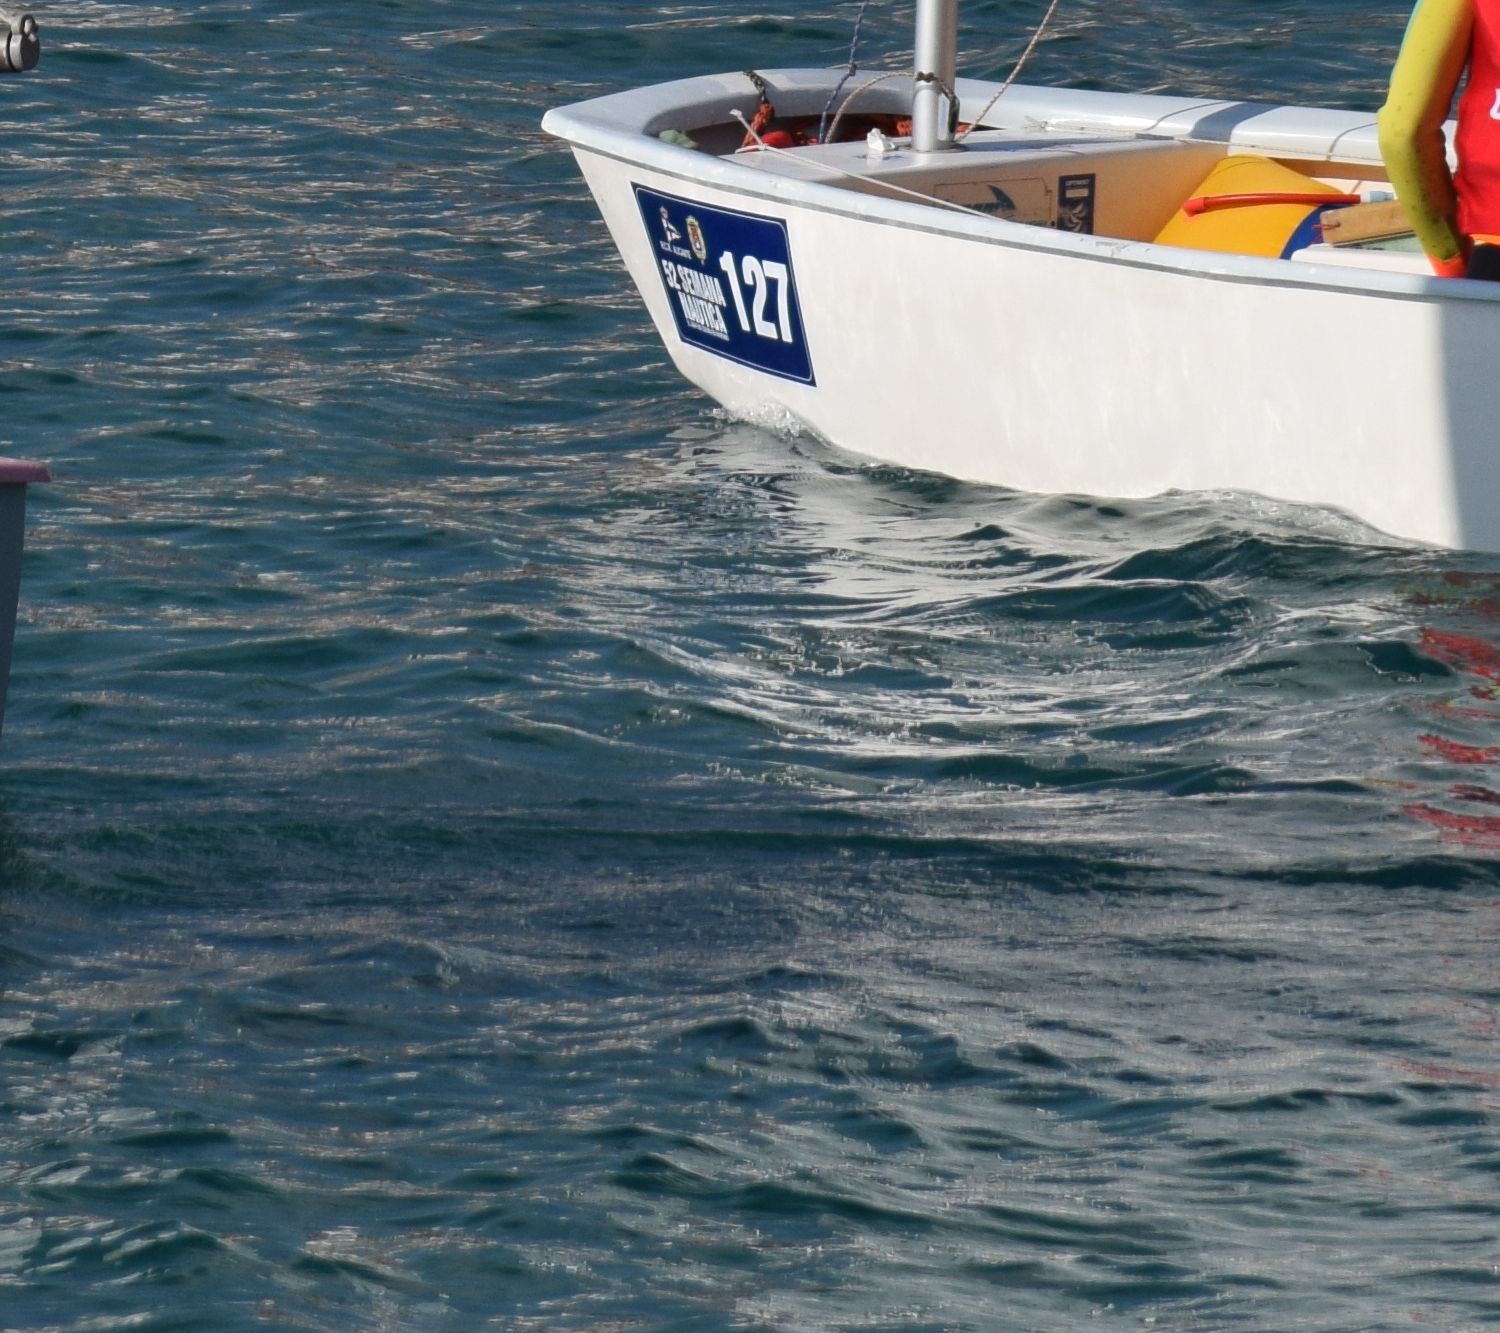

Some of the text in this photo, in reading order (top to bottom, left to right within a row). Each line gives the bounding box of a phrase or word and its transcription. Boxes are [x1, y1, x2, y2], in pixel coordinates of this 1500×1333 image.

[661, 259, 728, 308] 52 SEMANA
[718, 250, 793, 344] 127
[678, 291, 729, 335] NAUTICA
